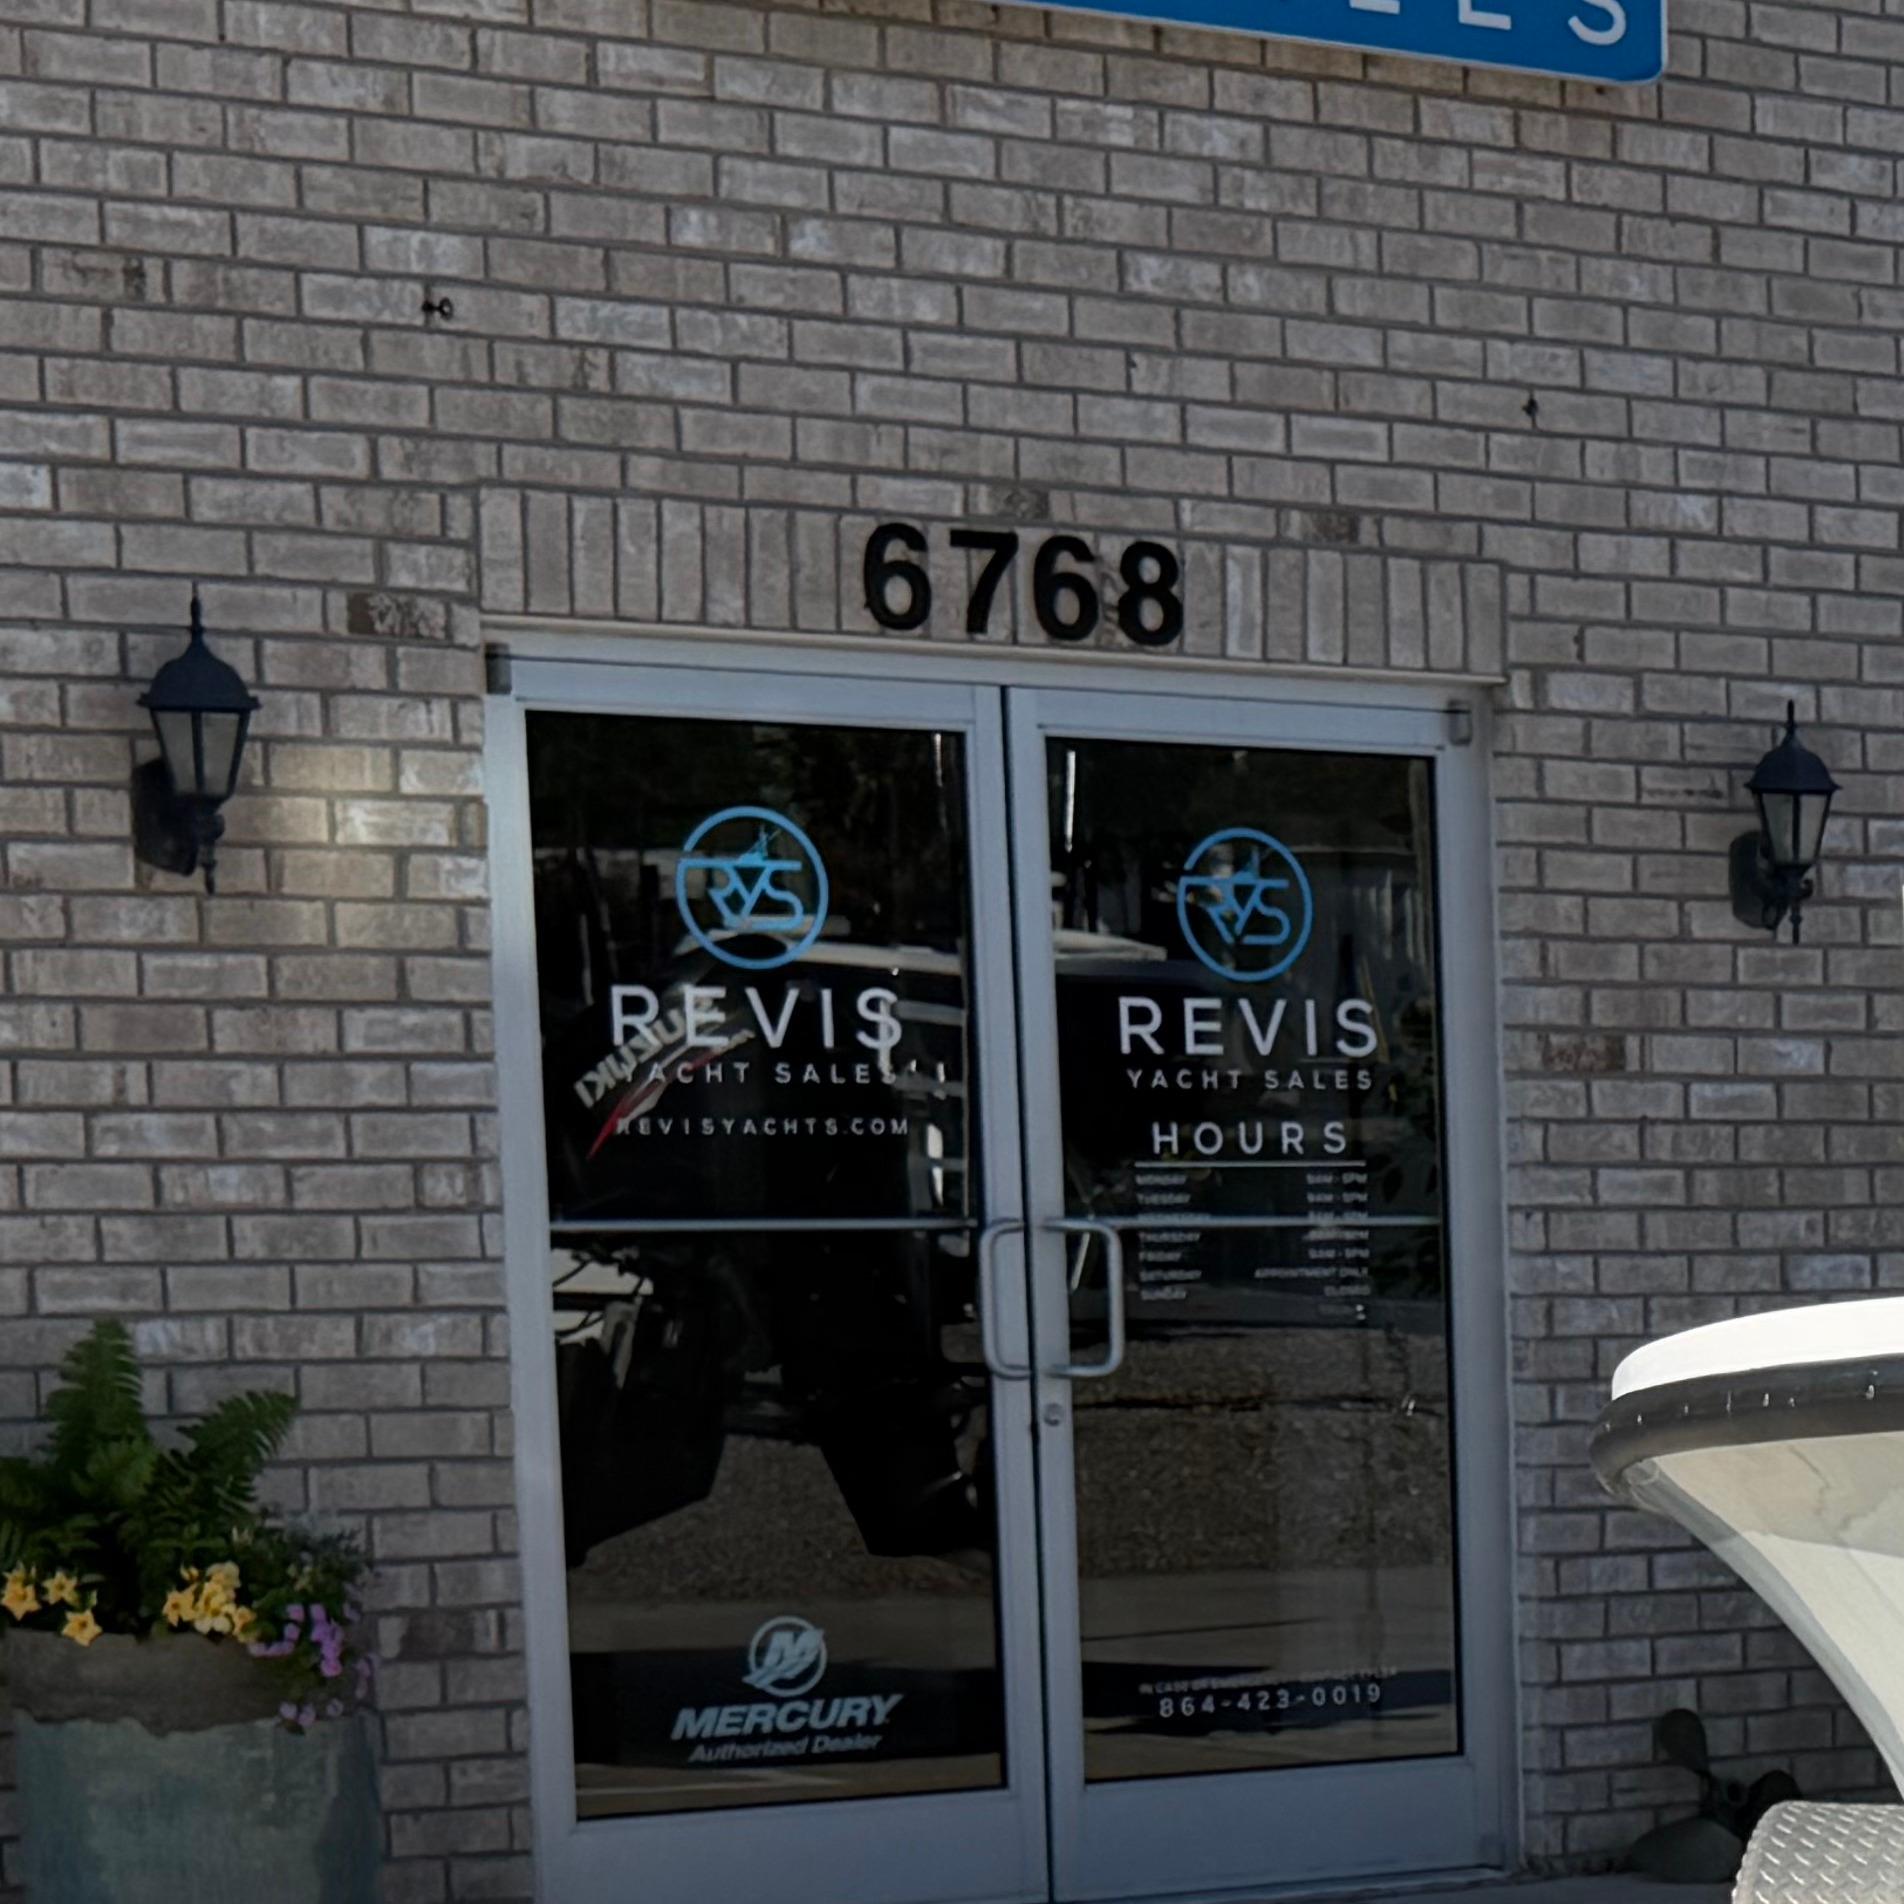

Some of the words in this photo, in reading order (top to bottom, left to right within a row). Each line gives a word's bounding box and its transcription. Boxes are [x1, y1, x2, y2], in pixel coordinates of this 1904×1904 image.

[862, 522, 1184, 646] 6768
[610, 984, 903, 1050] REVIS
[1119, 996, 1378, 1058] REVIS
[622, 1062, 750, 1085] YACHT
[774, 1062, 898, 1085] SALES
[1126, 1068, 1244, 1090] YACHT
[1264, 1068, 1373, 1091] SALES
[615, 1116, 909, 1137] REVISYACHTS.COM
[1151, 1120, 1348, 1155] HOURS
[670, 1693, 905, 1741] MERCURY
[1159, 1682, 1381, 1718] 864-423-0019
[688, 1736, 810, 1764] Authorized
[812, 1732, 884, 1755] Dealer
